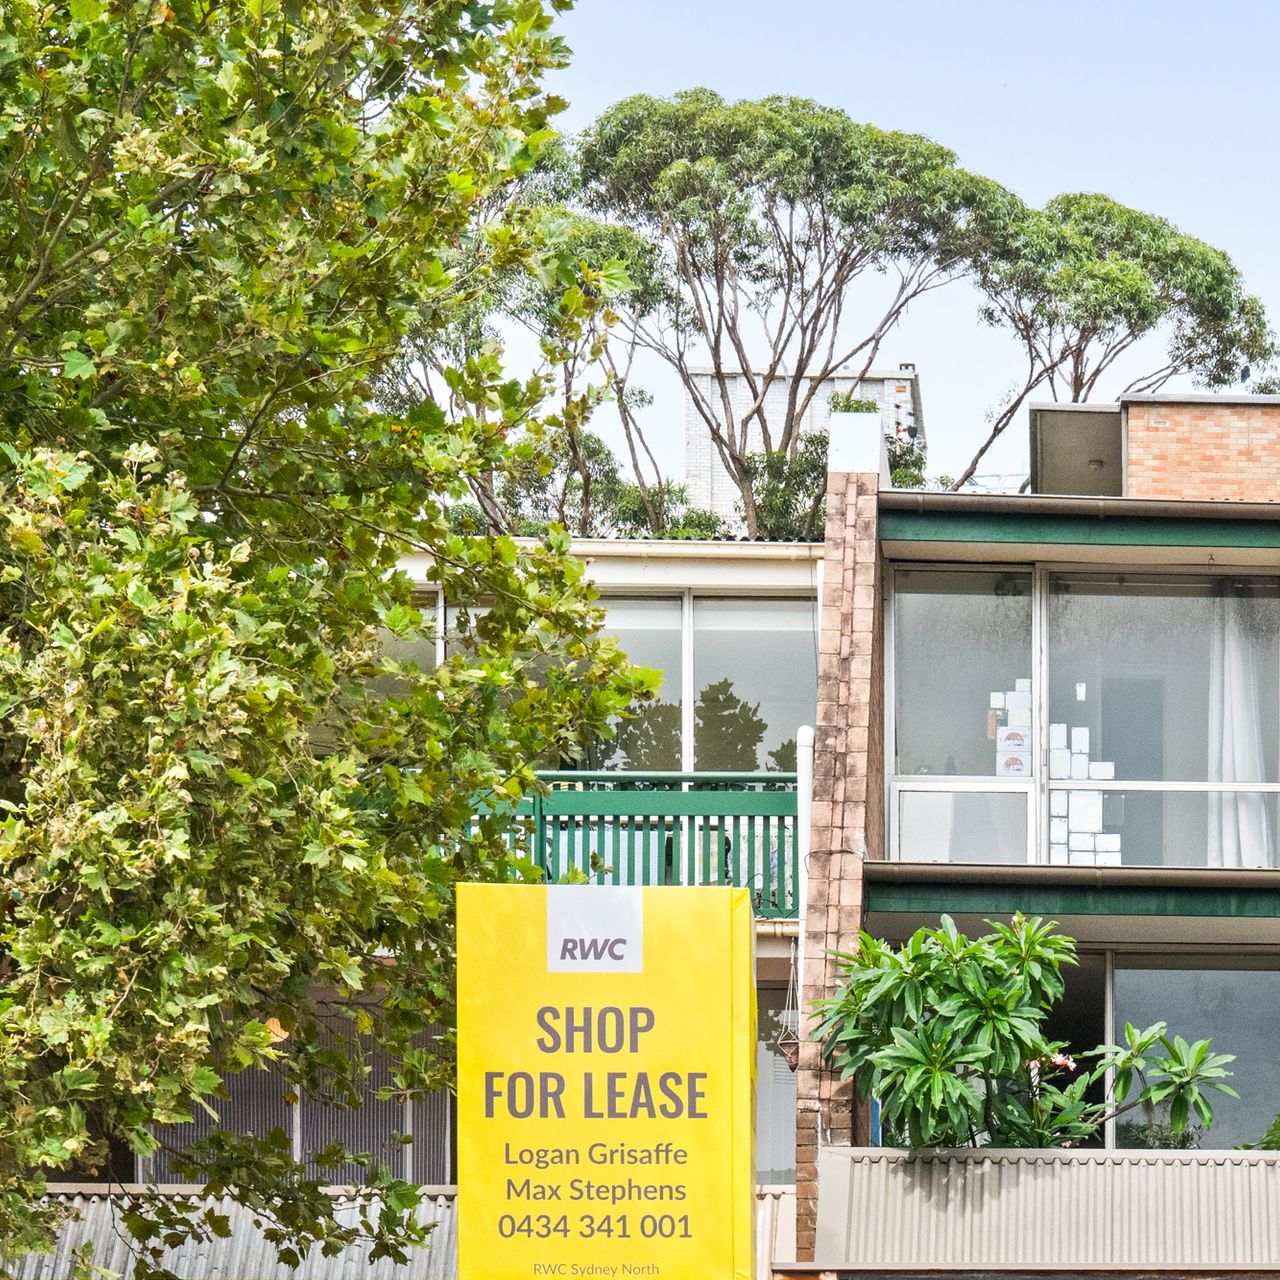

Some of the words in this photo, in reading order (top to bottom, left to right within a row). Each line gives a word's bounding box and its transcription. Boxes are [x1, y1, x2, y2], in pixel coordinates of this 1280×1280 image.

[560, 938, 627, 961] RWC
[536, 1006, 655, 1054] SHOP
[484, 1072, 566, 1119] FOR
[583, 1072, 708, 1119] LEASE
[504, 1143, 580, 1169] Logan
[588, 1143, 688, 1166] Grisaffe
[506, 1179, 561, 1200] Max
[569, 1178, 687, 1205] Stephens
[498, 1215, 570, 1238] 0434
[578, 1215, 631, 1238] 341
[640, 1215, 692, 1238] 001
[533, 1263, 568, 1275] RWC
[571, 1263, 618, 1278] Sydney
[622, 1262, 659, 1275] North
